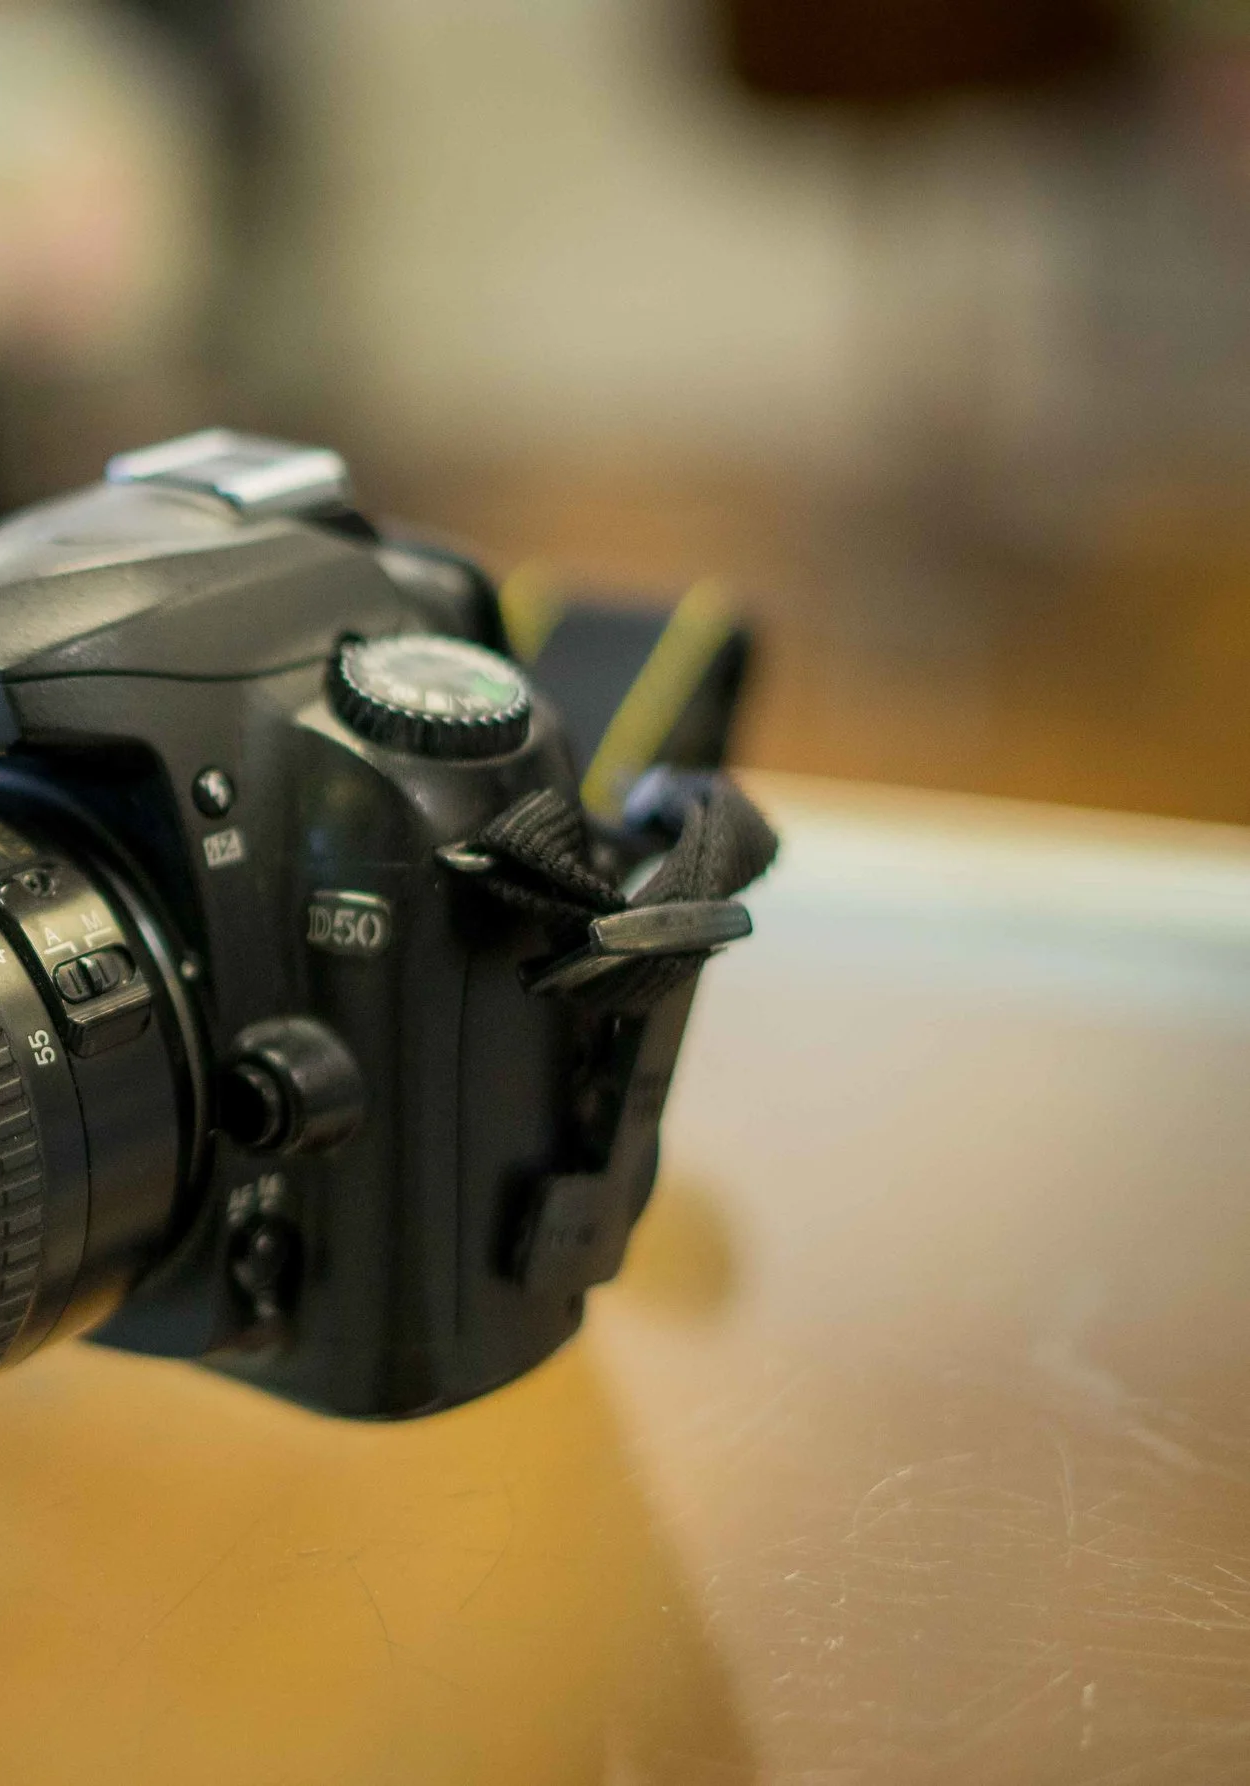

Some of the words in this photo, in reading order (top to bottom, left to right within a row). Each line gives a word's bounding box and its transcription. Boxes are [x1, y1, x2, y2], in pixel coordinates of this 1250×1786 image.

[44, 926, 62, 946] A
[80, 909, 103, 933] M
[307, 906, 381, 948] D50
[27, 1029, 56, 1067] 55
